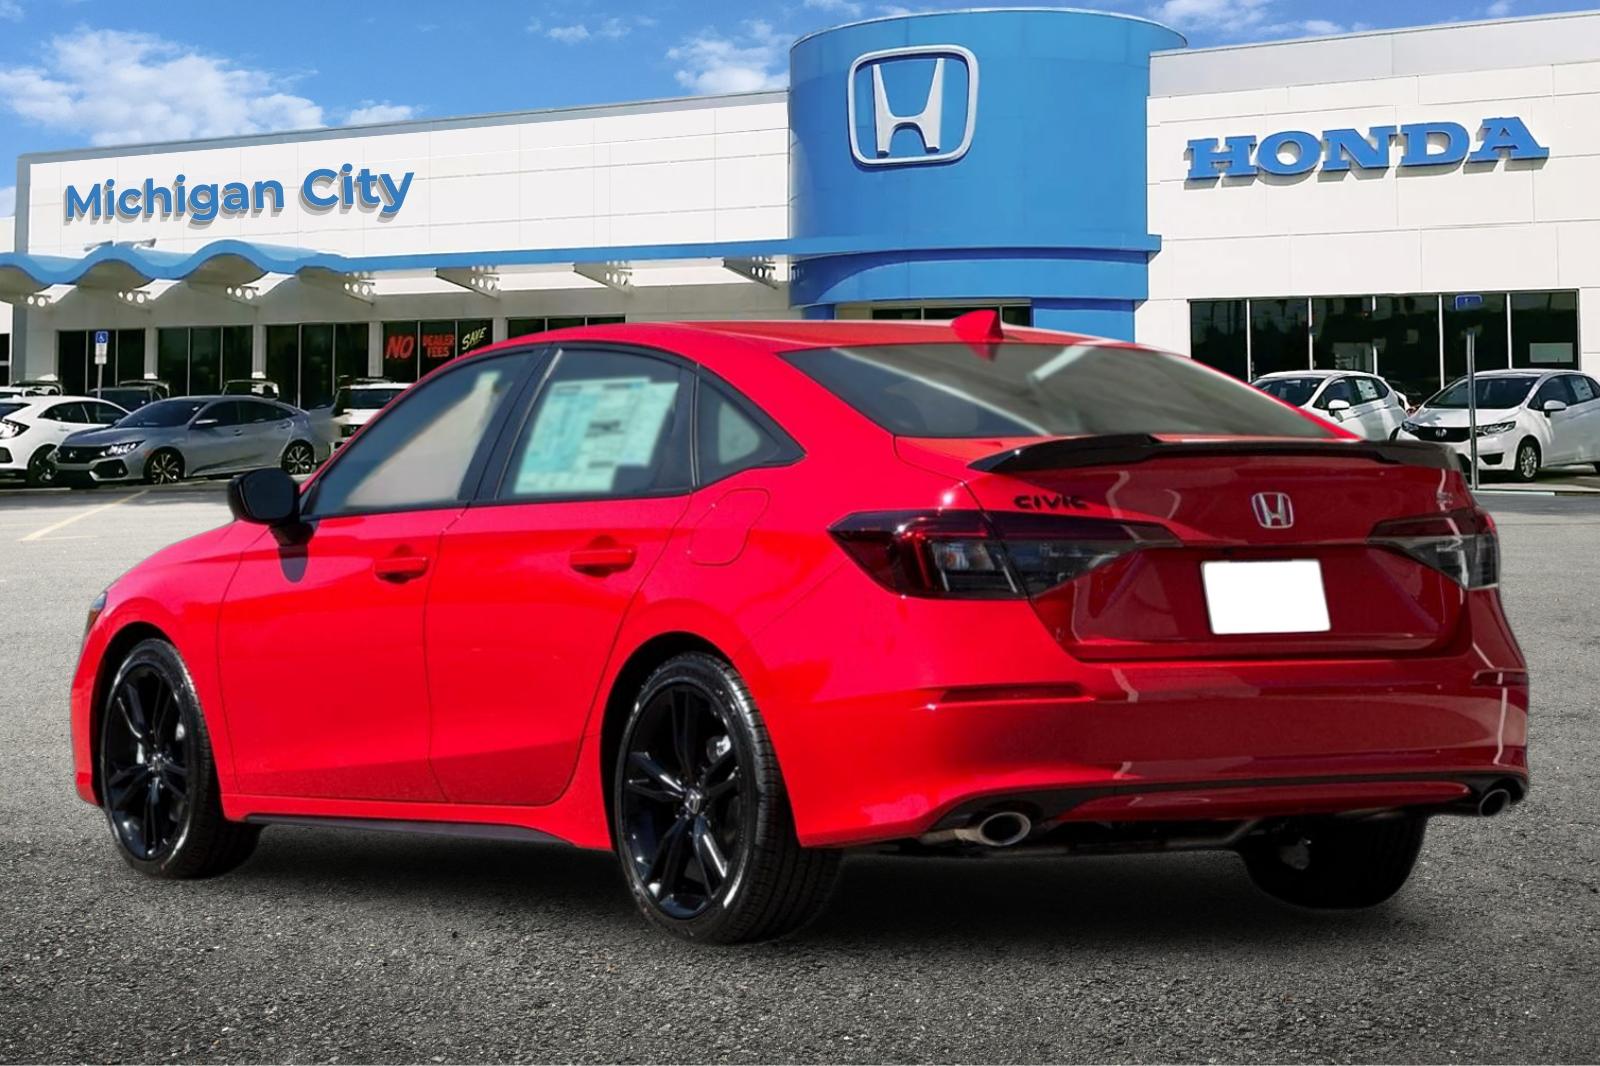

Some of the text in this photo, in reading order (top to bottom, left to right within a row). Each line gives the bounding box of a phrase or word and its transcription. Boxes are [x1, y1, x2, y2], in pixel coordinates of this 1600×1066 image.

[1186, 116, 1550, 181] HONDA
[65, 162, 415, 222] Michigan City
[384, 335, 415, 359] NO
[461, 326, 488, 350] SAVE
[1013, 494, 1090, 510] CIVIC
